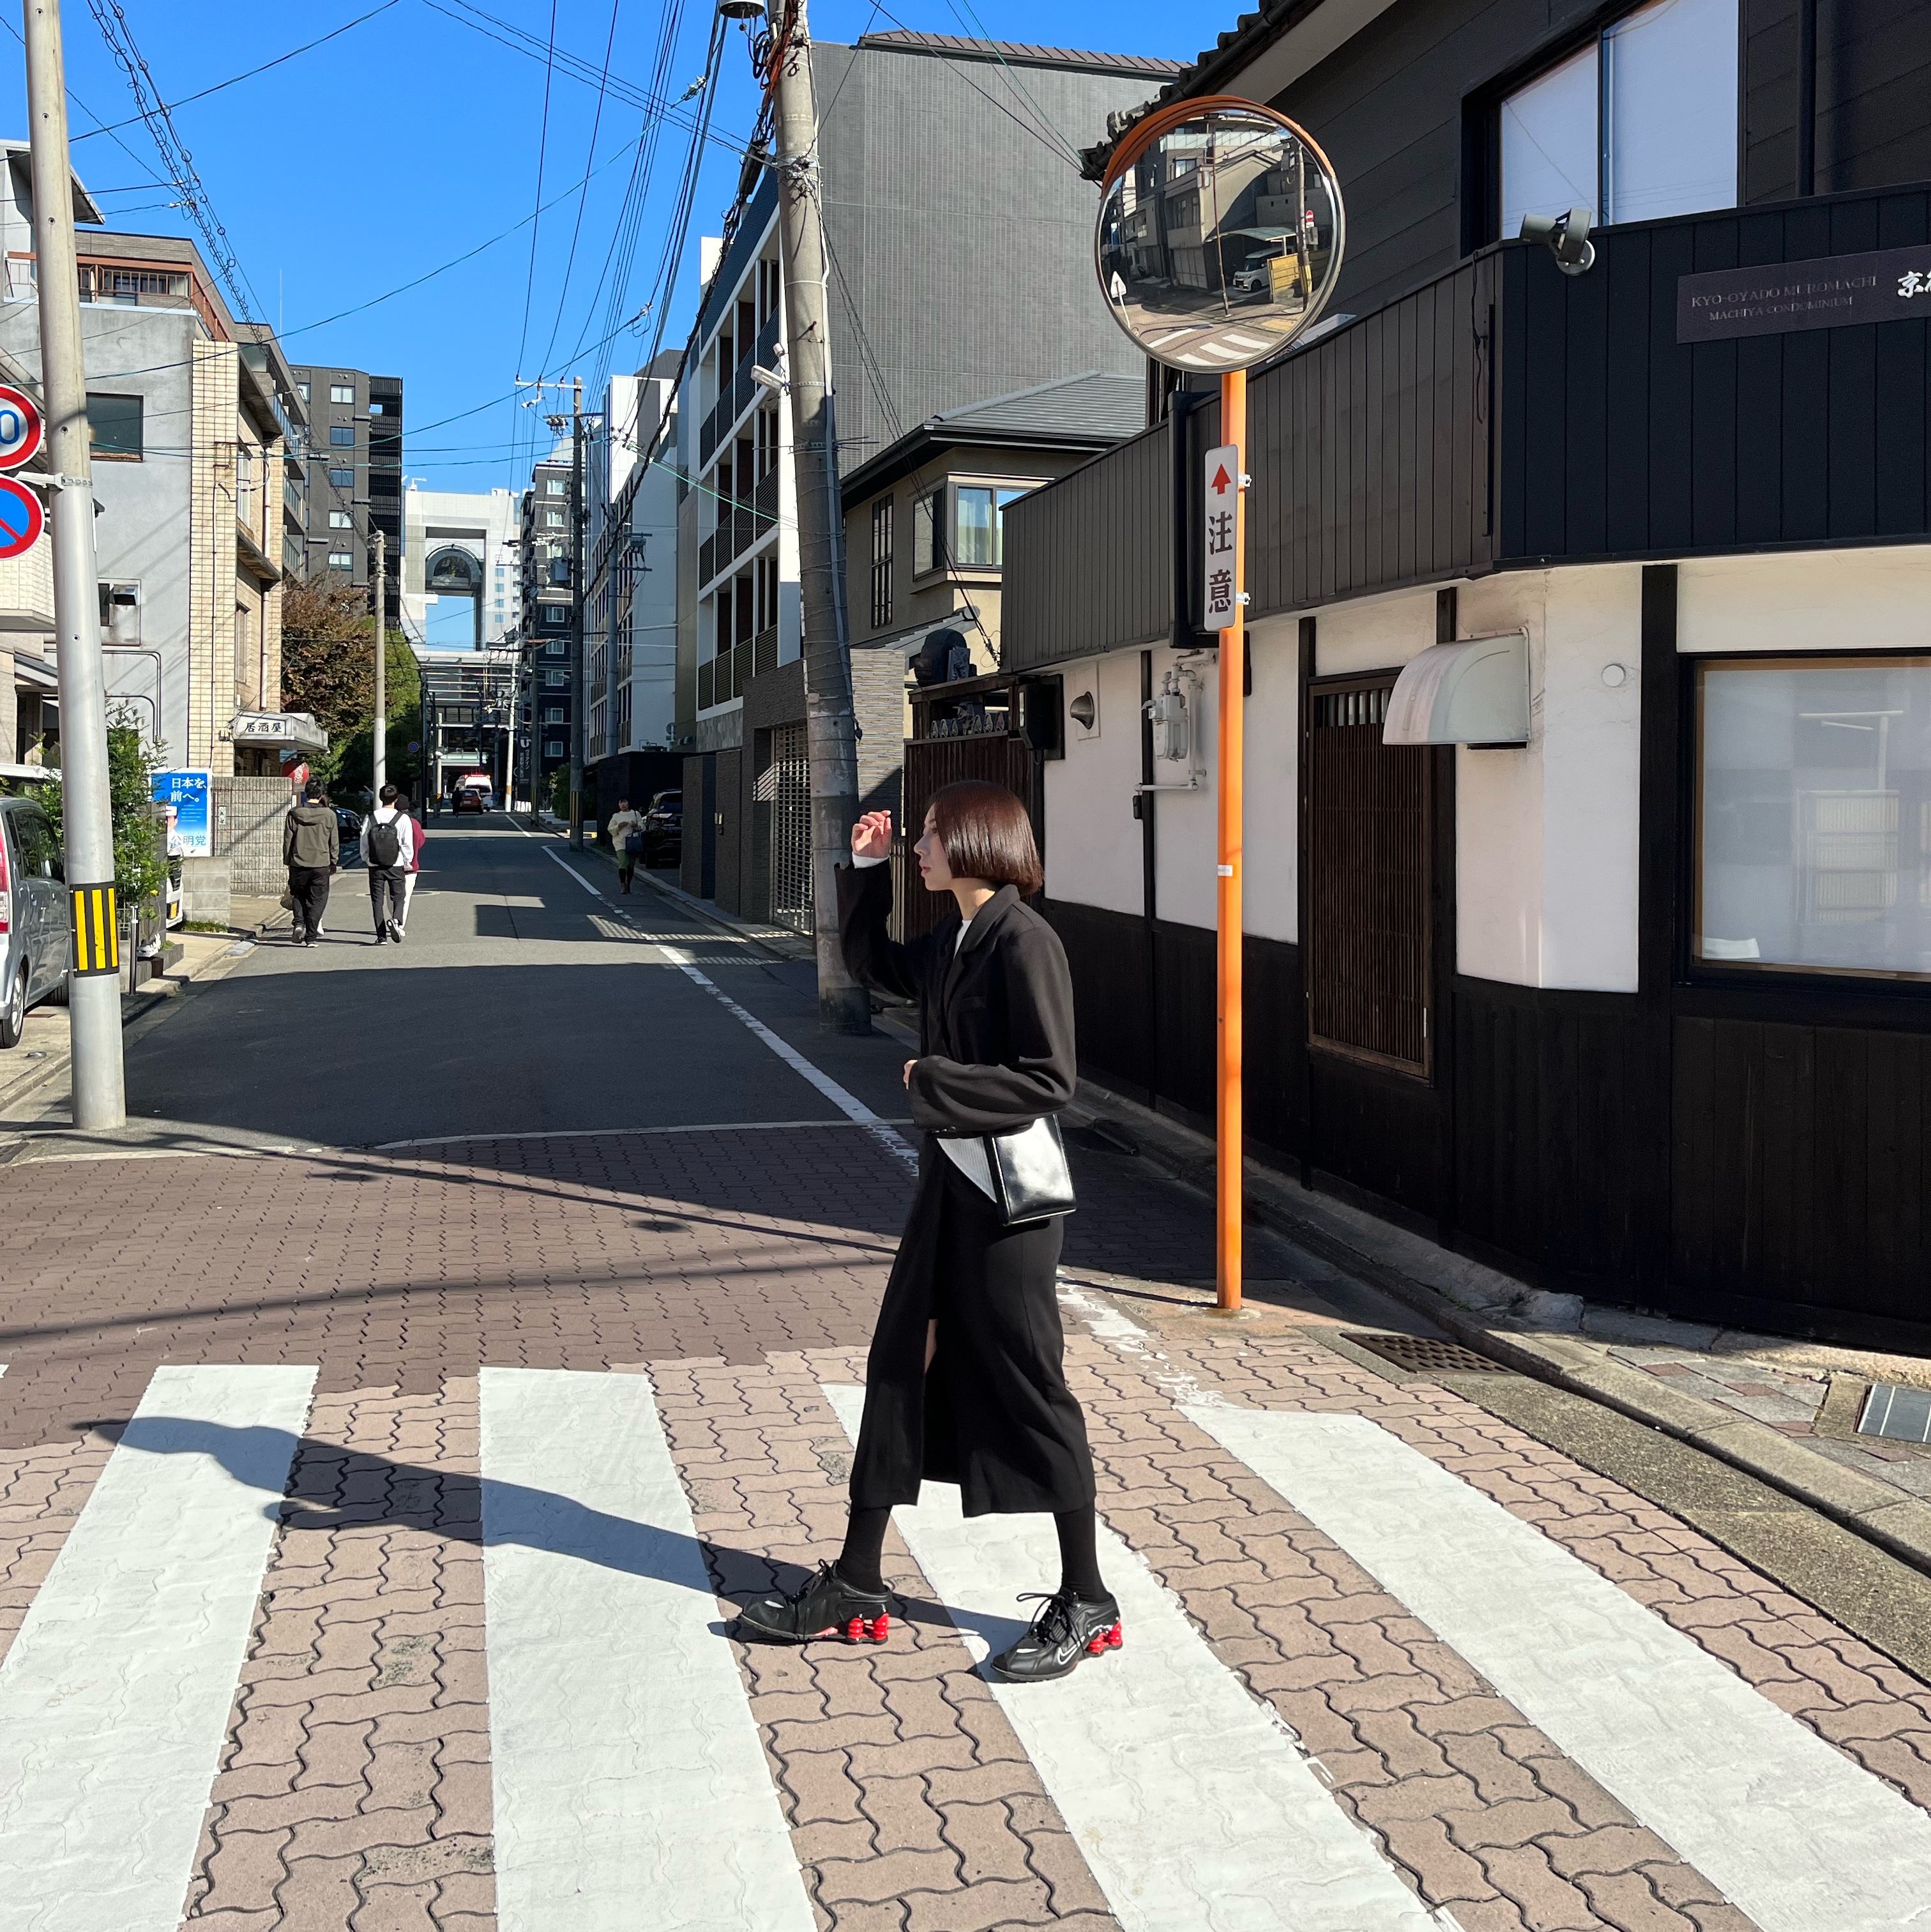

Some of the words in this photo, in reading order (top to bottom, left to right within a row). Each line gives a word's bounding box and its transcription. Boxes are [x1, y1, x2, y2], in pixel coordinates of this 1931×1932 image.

[1692, 288, 1780, 307] KYO-OYADO
[1784, 277, 1876, 296] MUROMACHI
[1897, 271, 1931, 298] 京
[1709, 307, 1763, 321] MACHIYA
[1767, 296, 1852, 314] CONDOMINIUM
[1208, 511, 1233, 614] 注意
[246, 722, 282, 733] 居酒屋
[172, 777, 207, 789] 日本を、
[170, 790, 200, 802] 前へ。
[170, 835, 206, 846] 公明党
